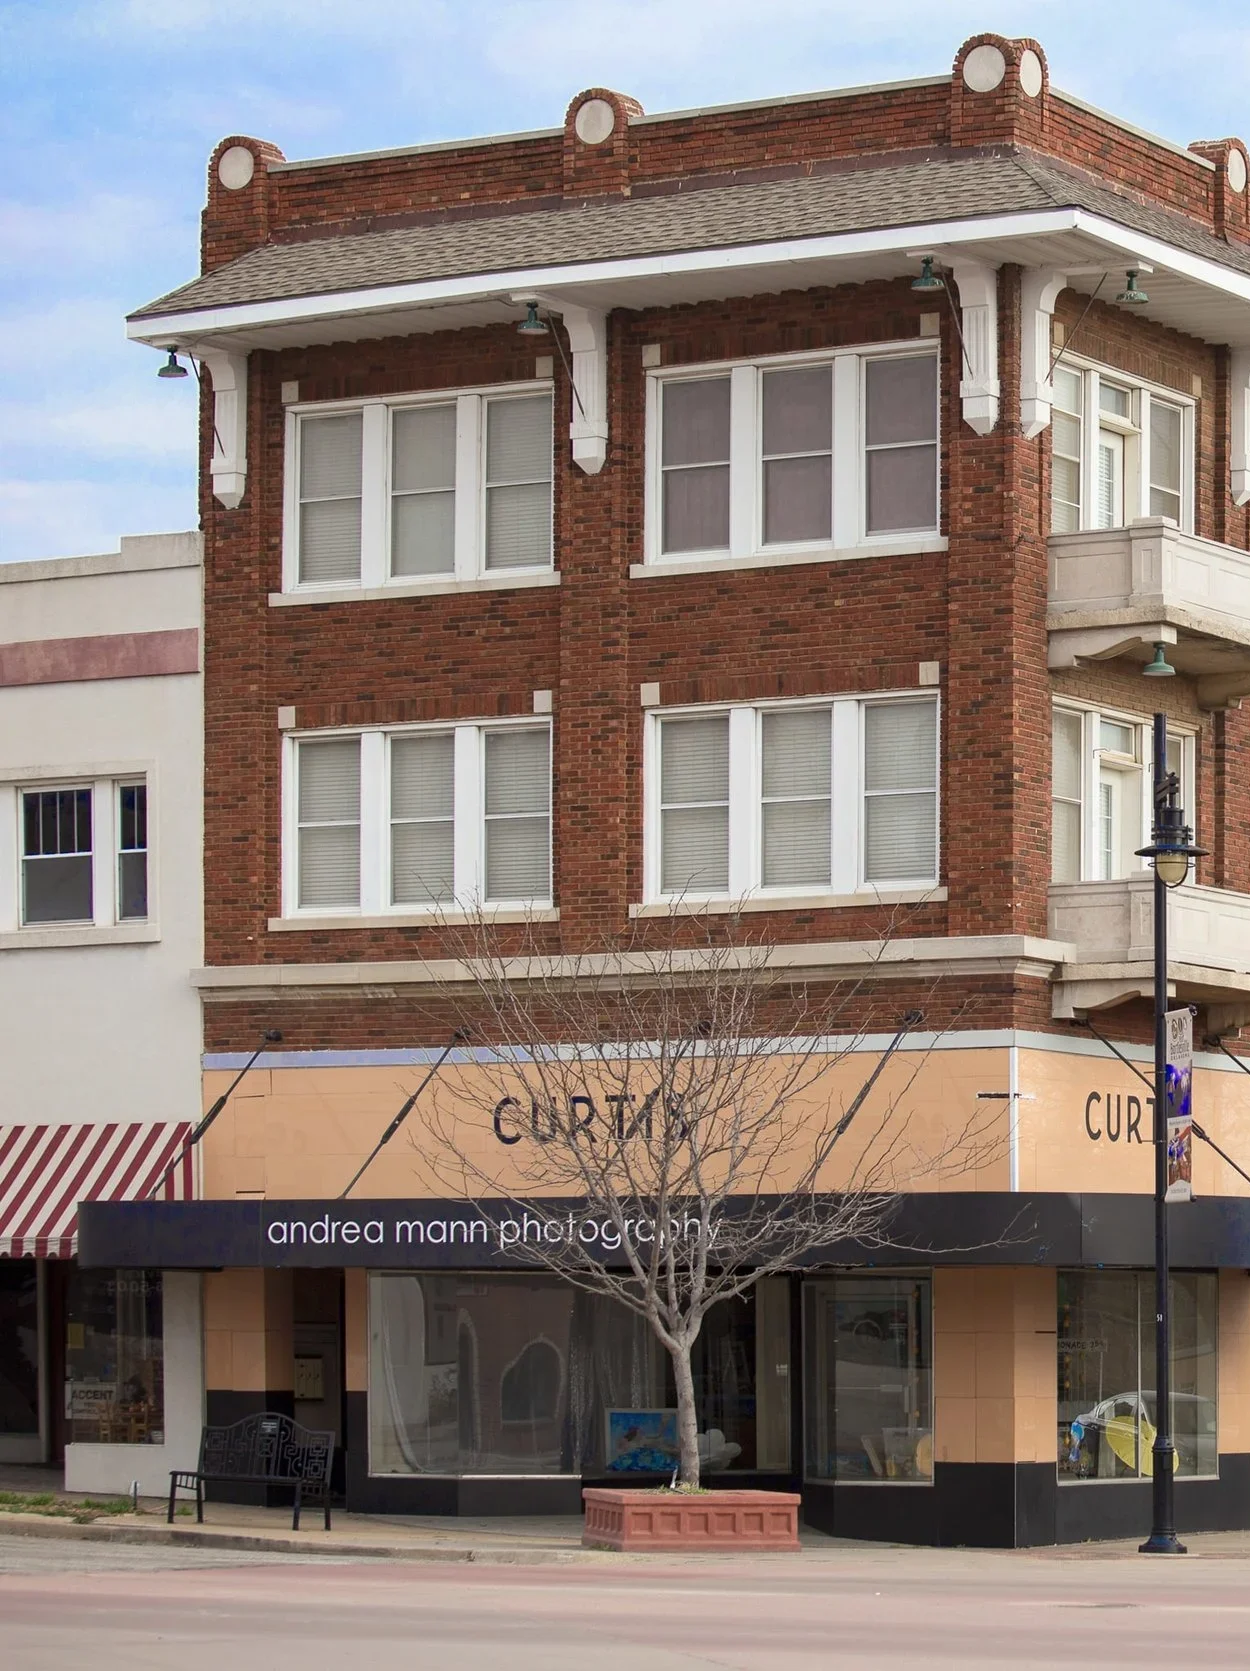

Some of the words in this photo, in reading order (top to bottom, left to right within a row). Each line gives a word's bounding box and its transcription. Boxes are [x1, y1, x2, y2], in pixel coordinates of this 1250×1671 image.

[494, 1094, 688, 1145] CURTIS
[1085, 1091, 1157, 1145] CURT
[267, 1214, 384, 1244] andrea
[395, 1220, 488, 1243] mann
[500, 1211, 723, 1250] photography
[71, 1390, 114, 1401] ACCENT
